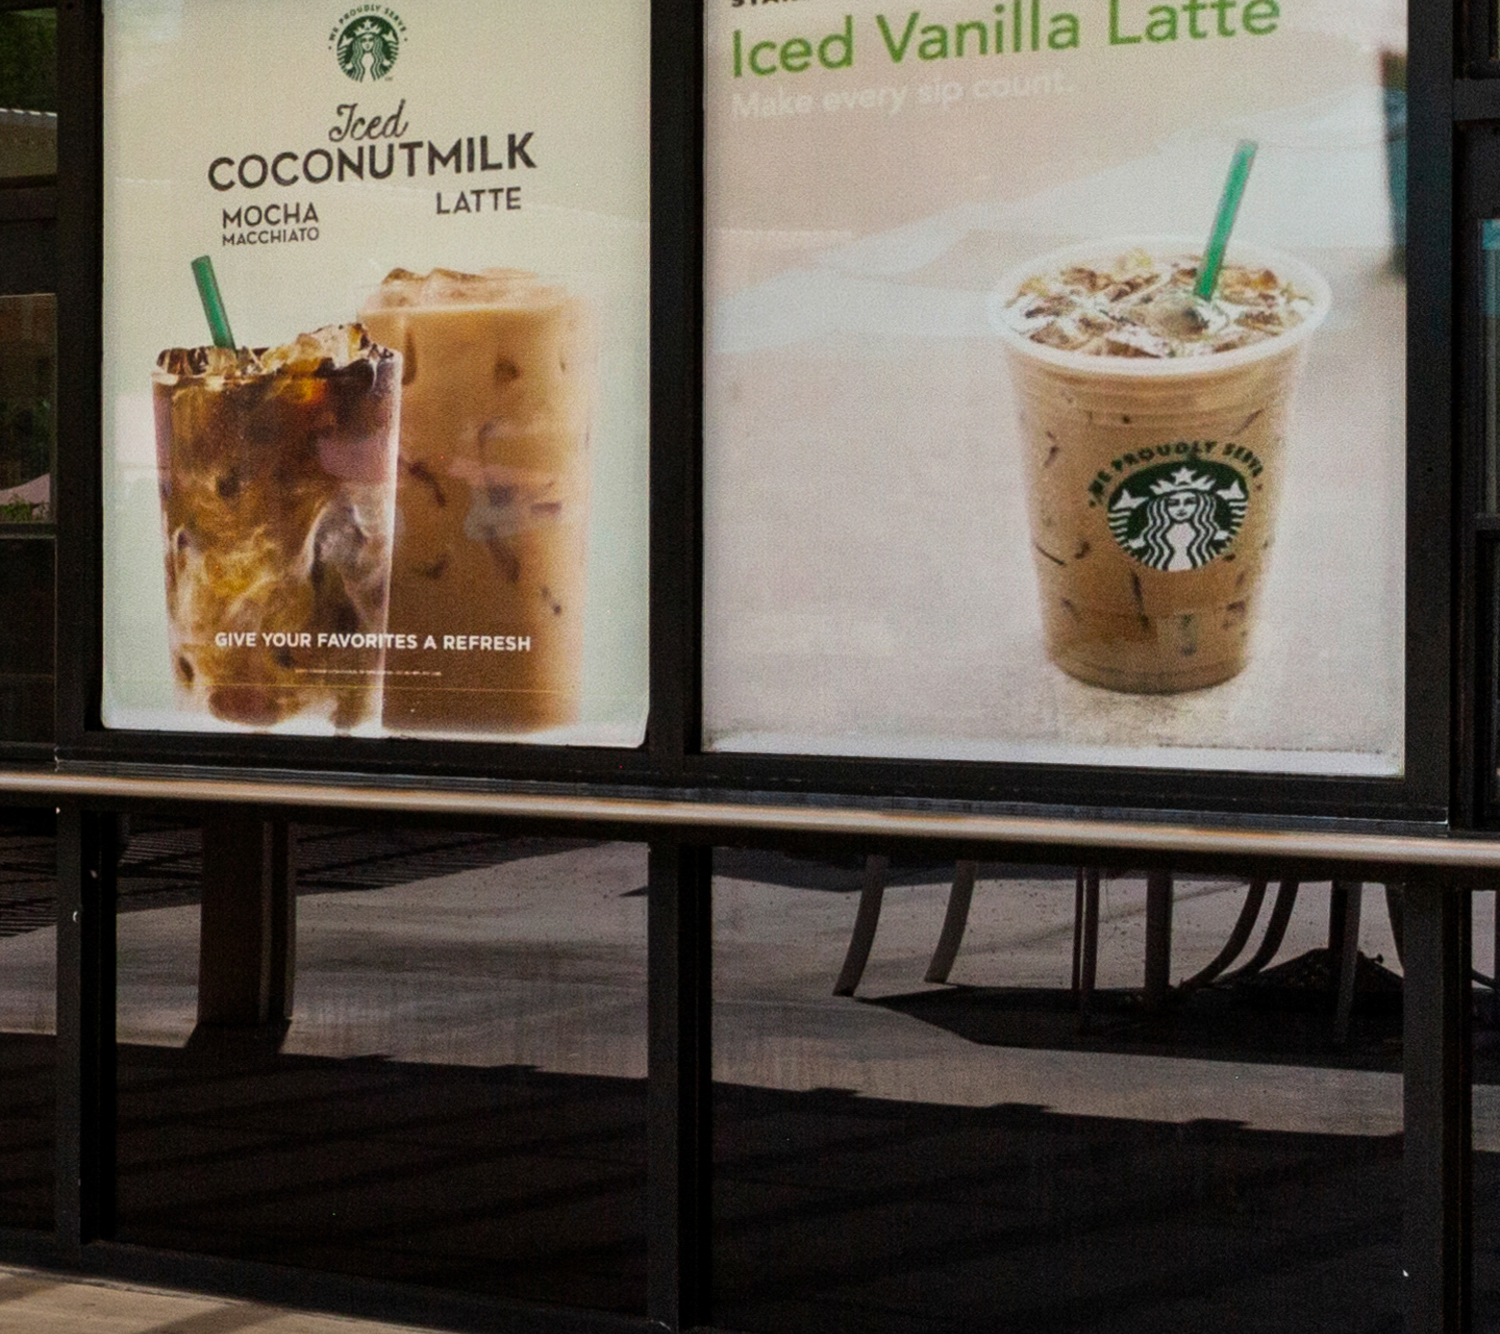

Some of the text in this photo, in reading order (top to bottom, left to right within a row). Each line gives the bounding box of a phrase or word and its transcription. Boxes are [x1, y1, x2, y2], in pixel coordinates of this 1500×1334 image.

[338, 3, 382, 24] PROUDLY
[384, 7, 407, 33] SERVE
[733, 16, 853, 77] Iced
[733, 88, 812, 120] Make
[823, 80, 908, 116] every
[918, 75, 965, 112] sip
[329, 99, 410, 142] Iced
[208, 131, 536, 192] COCONUTMILK
[222, 202, 319, 229] MOCHA
[436, 187, 521, 215] LATTE
[221, 228, 319, 247] MACCHIATO
[1111, 440, 1218, 472] PROUDLY
[215, 632, 531, 650] GIVE YOUR FAVORITES A REFRESH
